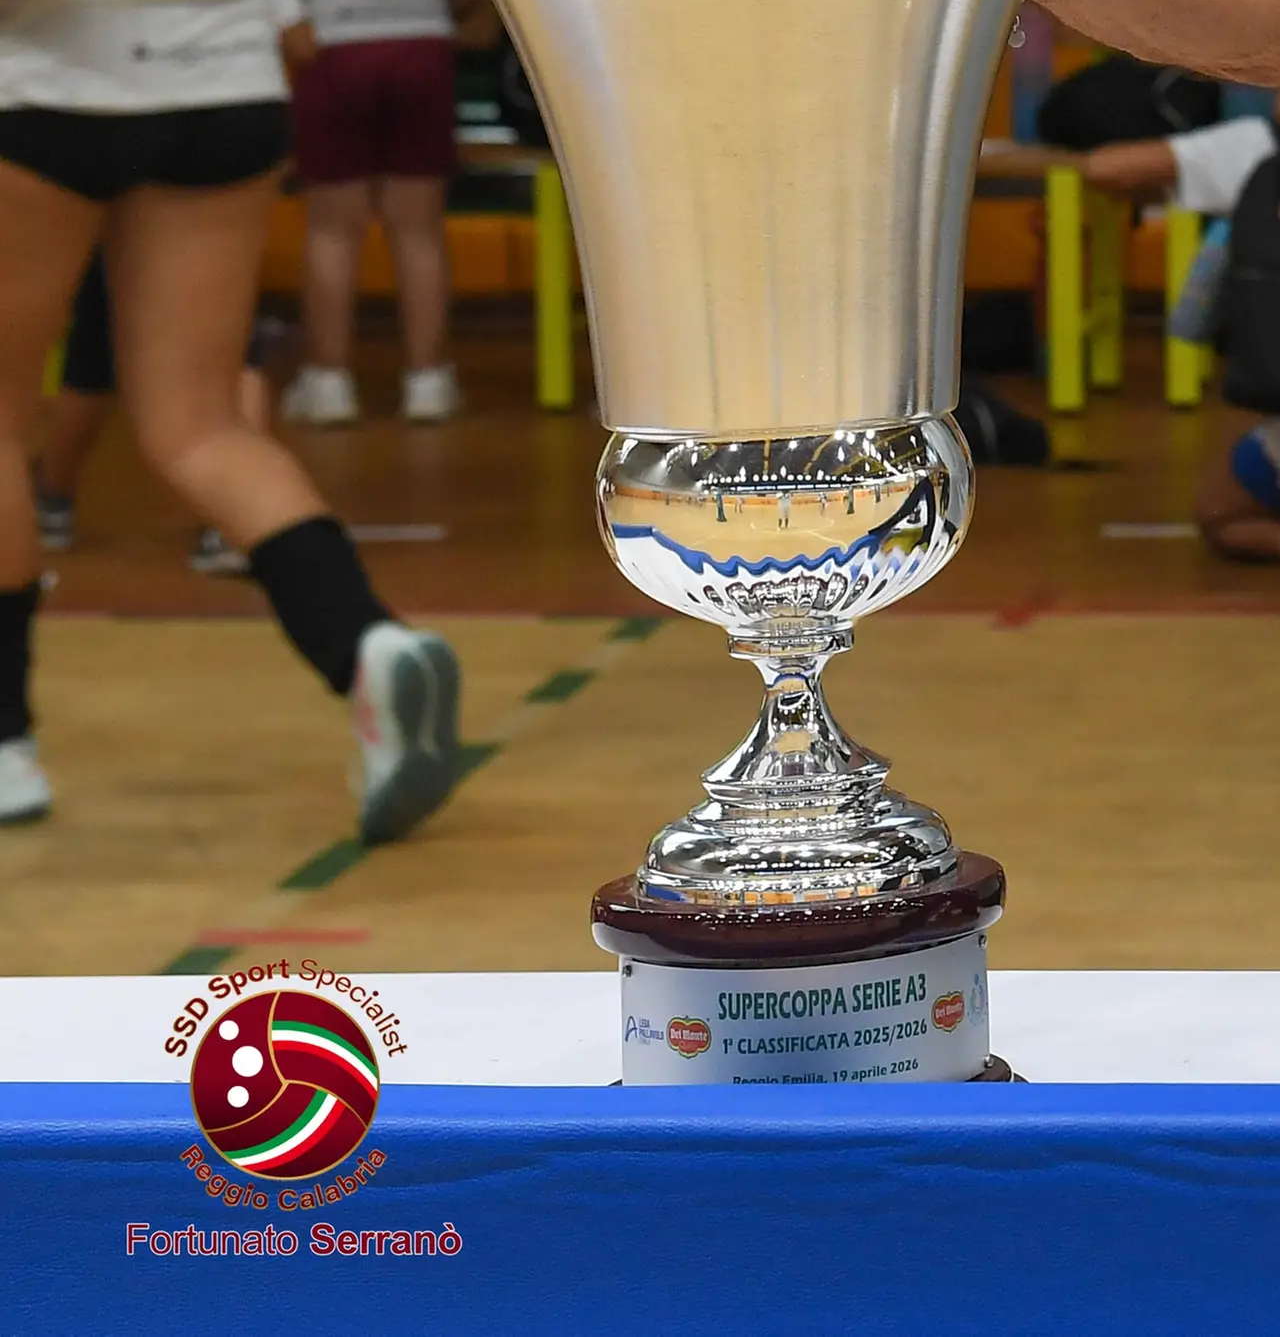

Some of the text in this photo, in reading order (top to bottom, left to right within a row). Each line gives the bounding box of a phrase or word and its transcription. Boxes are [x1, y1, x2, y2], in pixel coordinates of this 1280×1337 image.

[717, 973, 927, 1021] SUPERCOPPA SERIE A3
[738, 1032, 850, 1055] CLASSIFICATA
[854, 1019, 928, 1048] 2025/2026
[833, 1070, 848, 1082] 19
[851, 1064, 888, 1082] aprile
[890, 1058, 920, 1075] 2026
